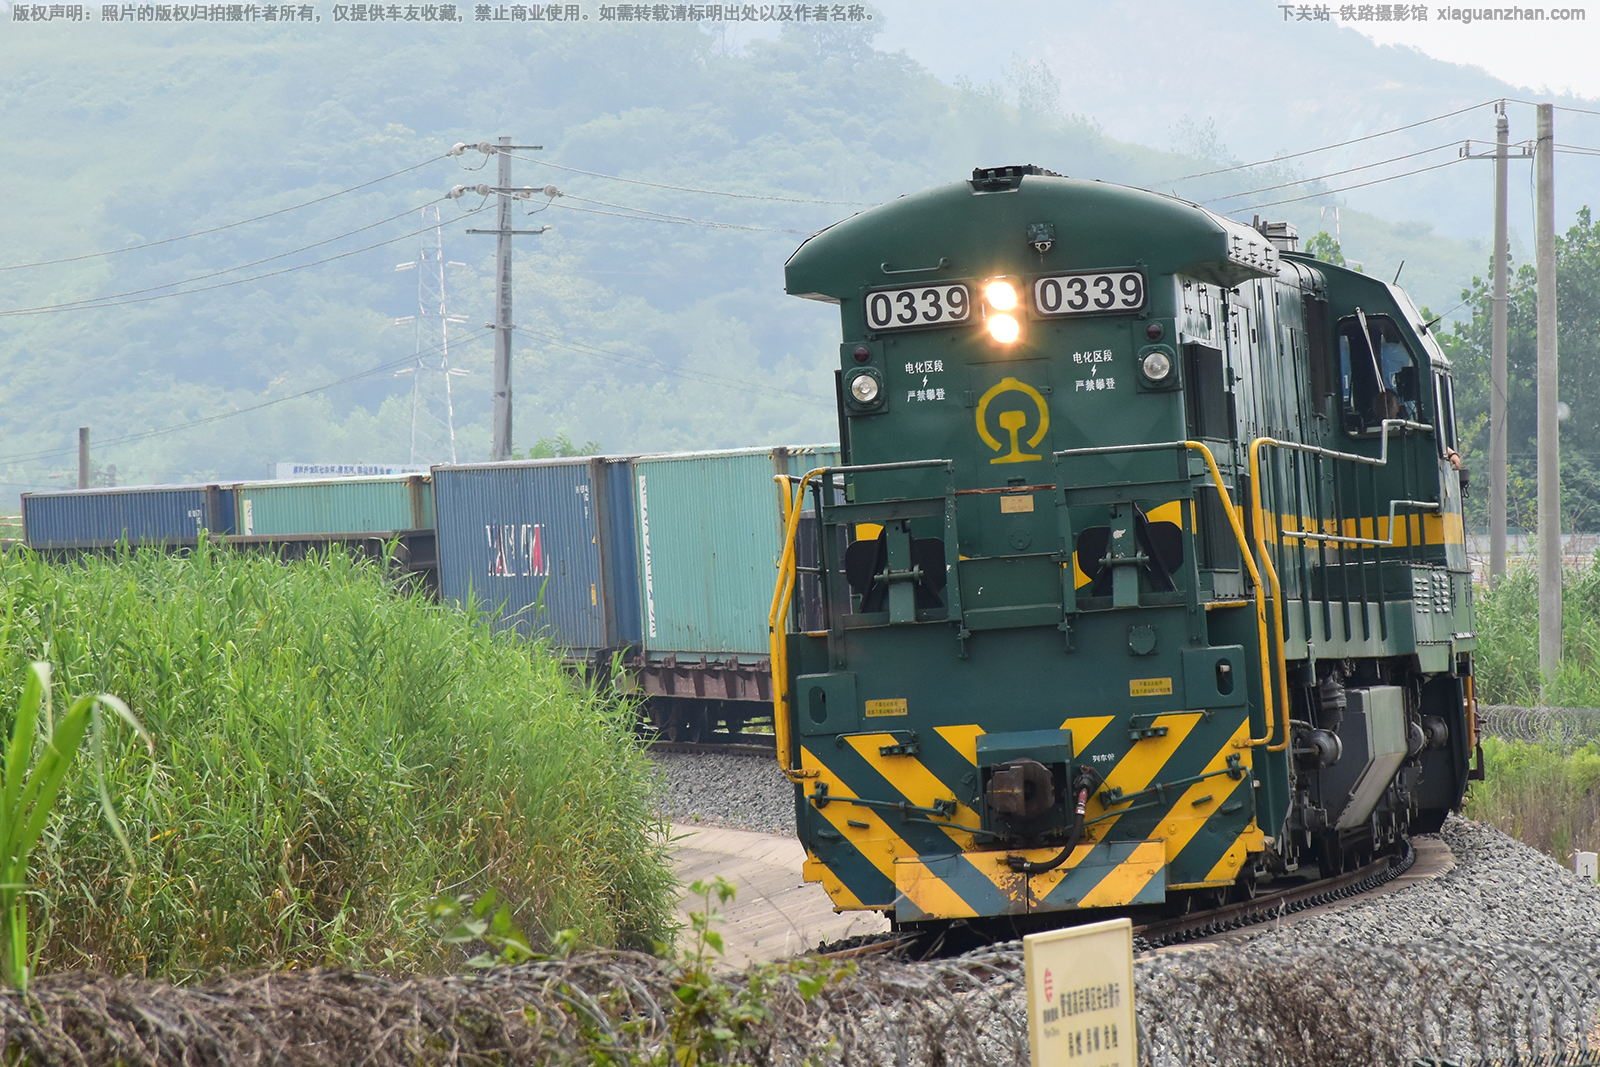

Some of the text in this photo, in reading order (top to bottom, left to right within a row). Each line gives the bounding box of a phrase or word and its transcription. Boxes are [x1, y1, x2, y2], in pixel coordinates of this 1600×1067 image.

[1040, 273, 1142, 312] 0339
[870, 286, 968, 326] 0339
[1073, 349, 1113, 364] 电化区段
[905, 359, 944, 374] 电化区段
[1075, 377, 1116, 392] 严禁攀登
[907, 387, 946, 402] 严禁攀登
